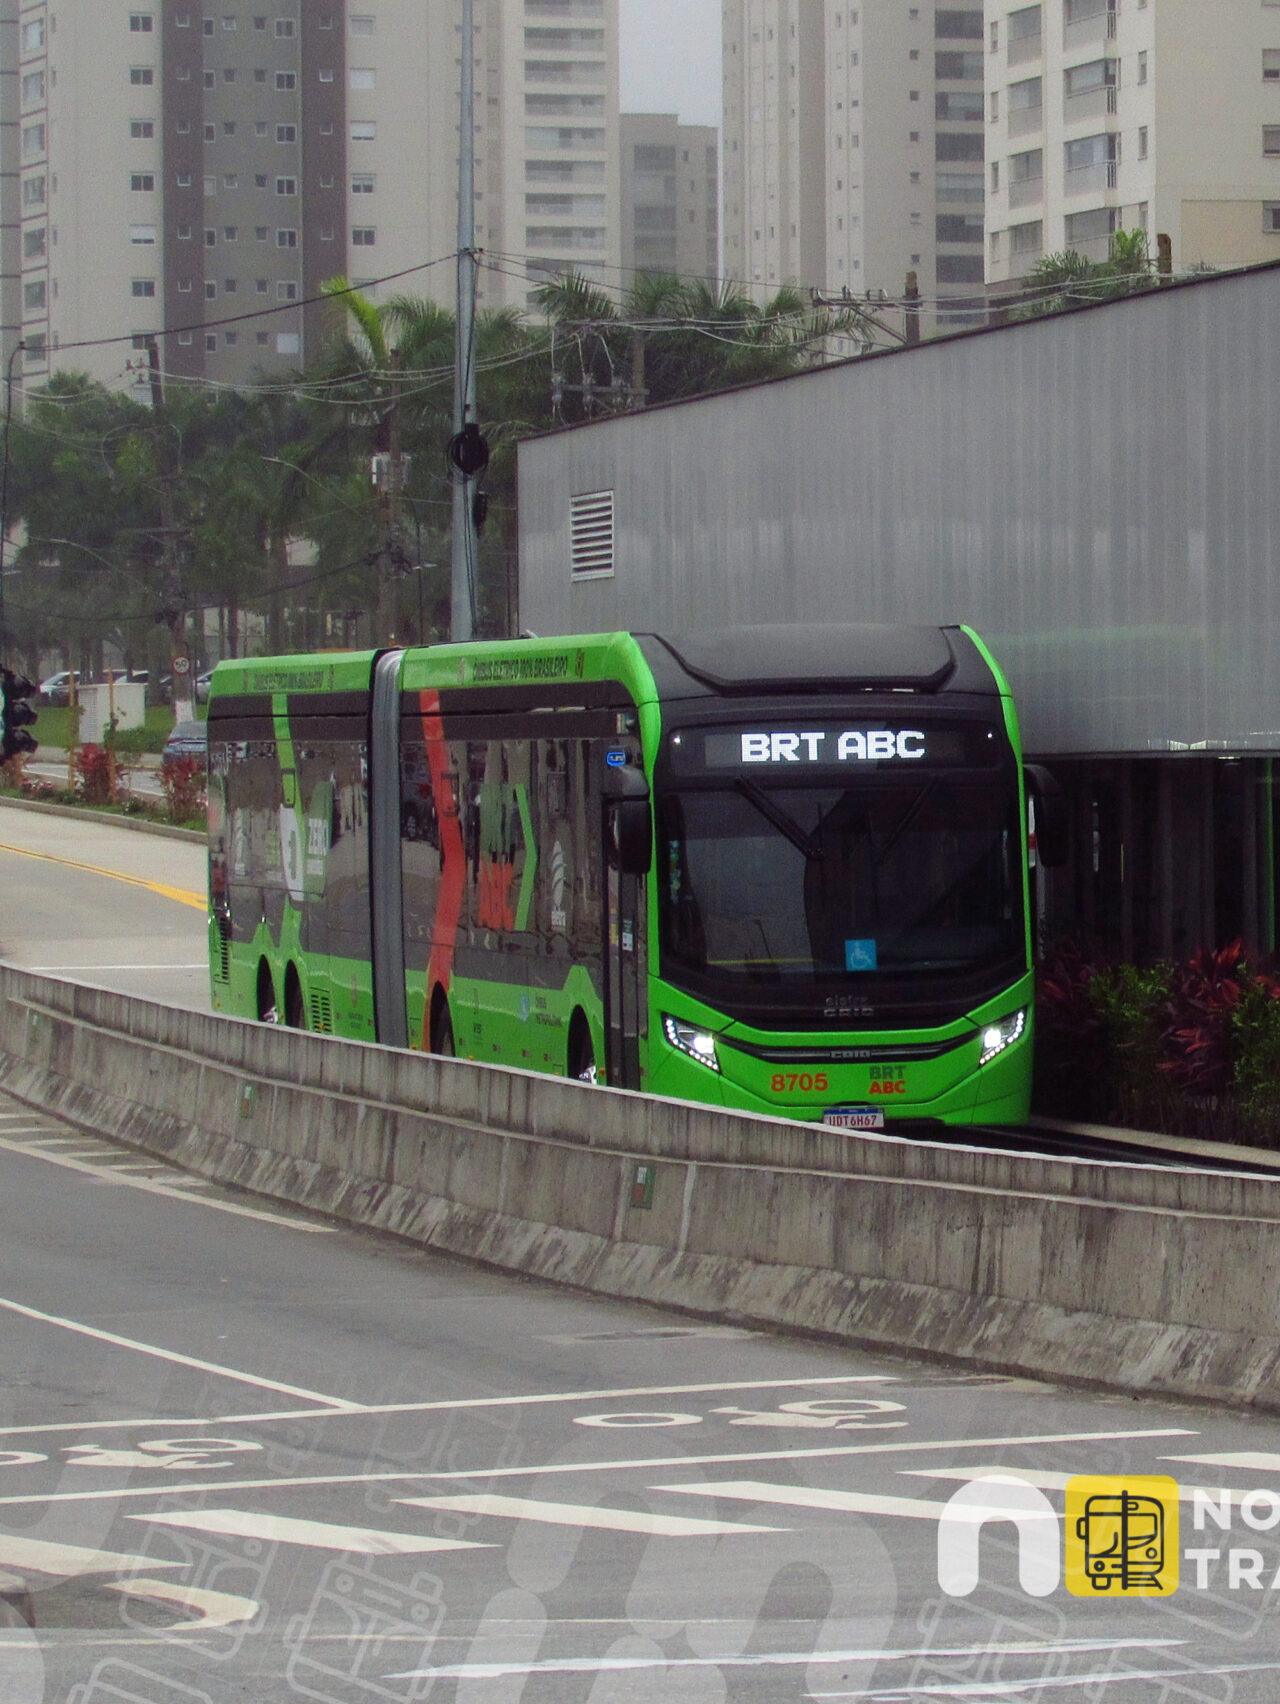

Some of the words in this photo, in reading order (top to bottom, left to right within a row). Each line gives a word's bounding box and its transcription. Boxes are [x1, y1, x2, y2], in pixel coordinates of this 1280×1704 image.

[741, 731, 826, 762] BRT
[837, 730, 926, 760] ABC
[869, 1065, 906, 1080] BRT
[770, 1073, 829, 1092] 8705
[868, 1080, 906, 1095] ABC
